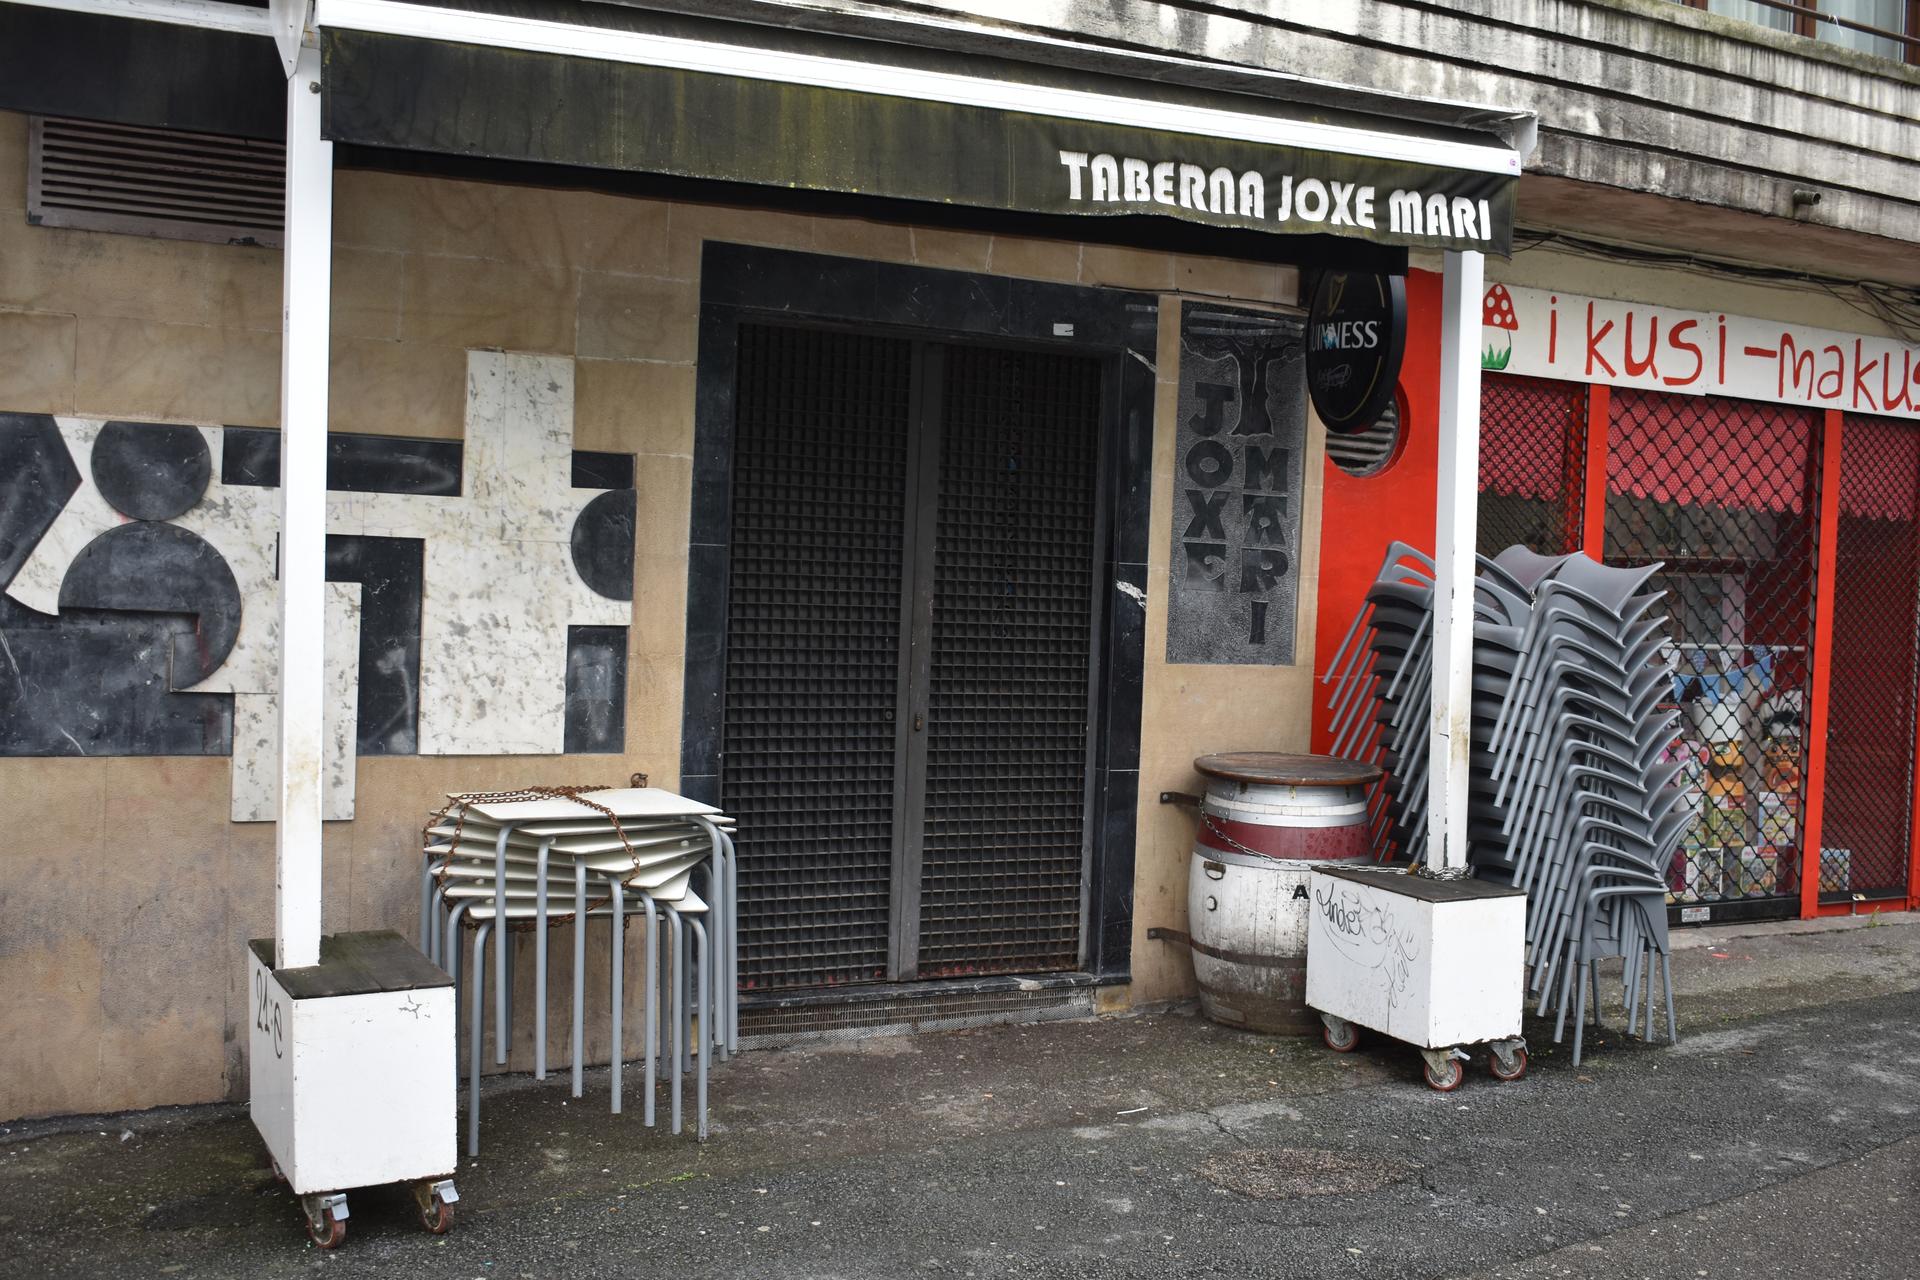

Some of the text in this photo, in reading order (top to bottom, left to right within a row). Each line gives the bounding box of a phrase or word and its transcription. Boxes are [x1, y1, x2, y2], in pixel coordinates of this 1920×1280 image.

[1059, 150, 1491, 241] TABERNA JOXE MARI
[1548, 295, 1920, 412] ikusi-maku
[1240, 445, 1289, 645] MARI
